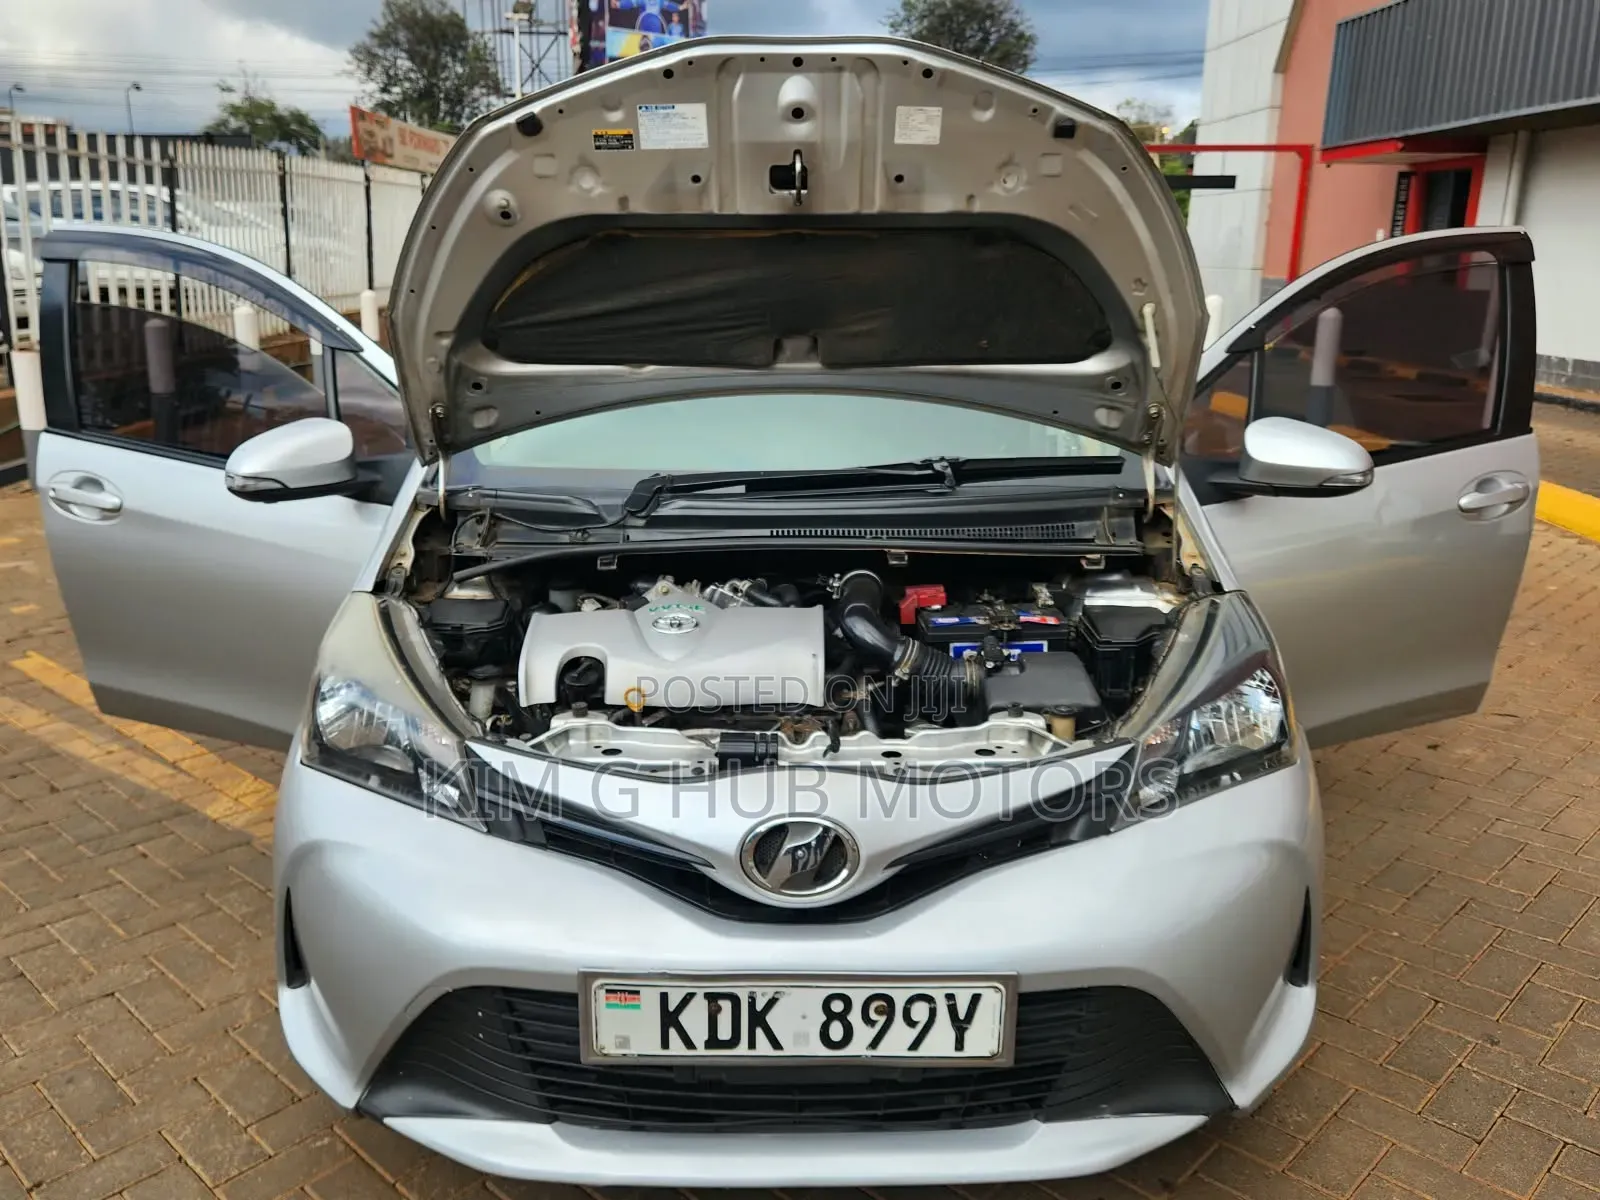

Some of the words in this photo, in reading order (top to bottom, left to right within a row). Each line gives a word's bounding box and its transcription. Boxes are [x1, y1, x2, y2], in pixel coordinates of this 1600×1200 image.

[1392, 203, 1405, 237] OLLECT
[659, 991, 784, 1050] KDK
[819, 992, 983, 1051] 899Y
